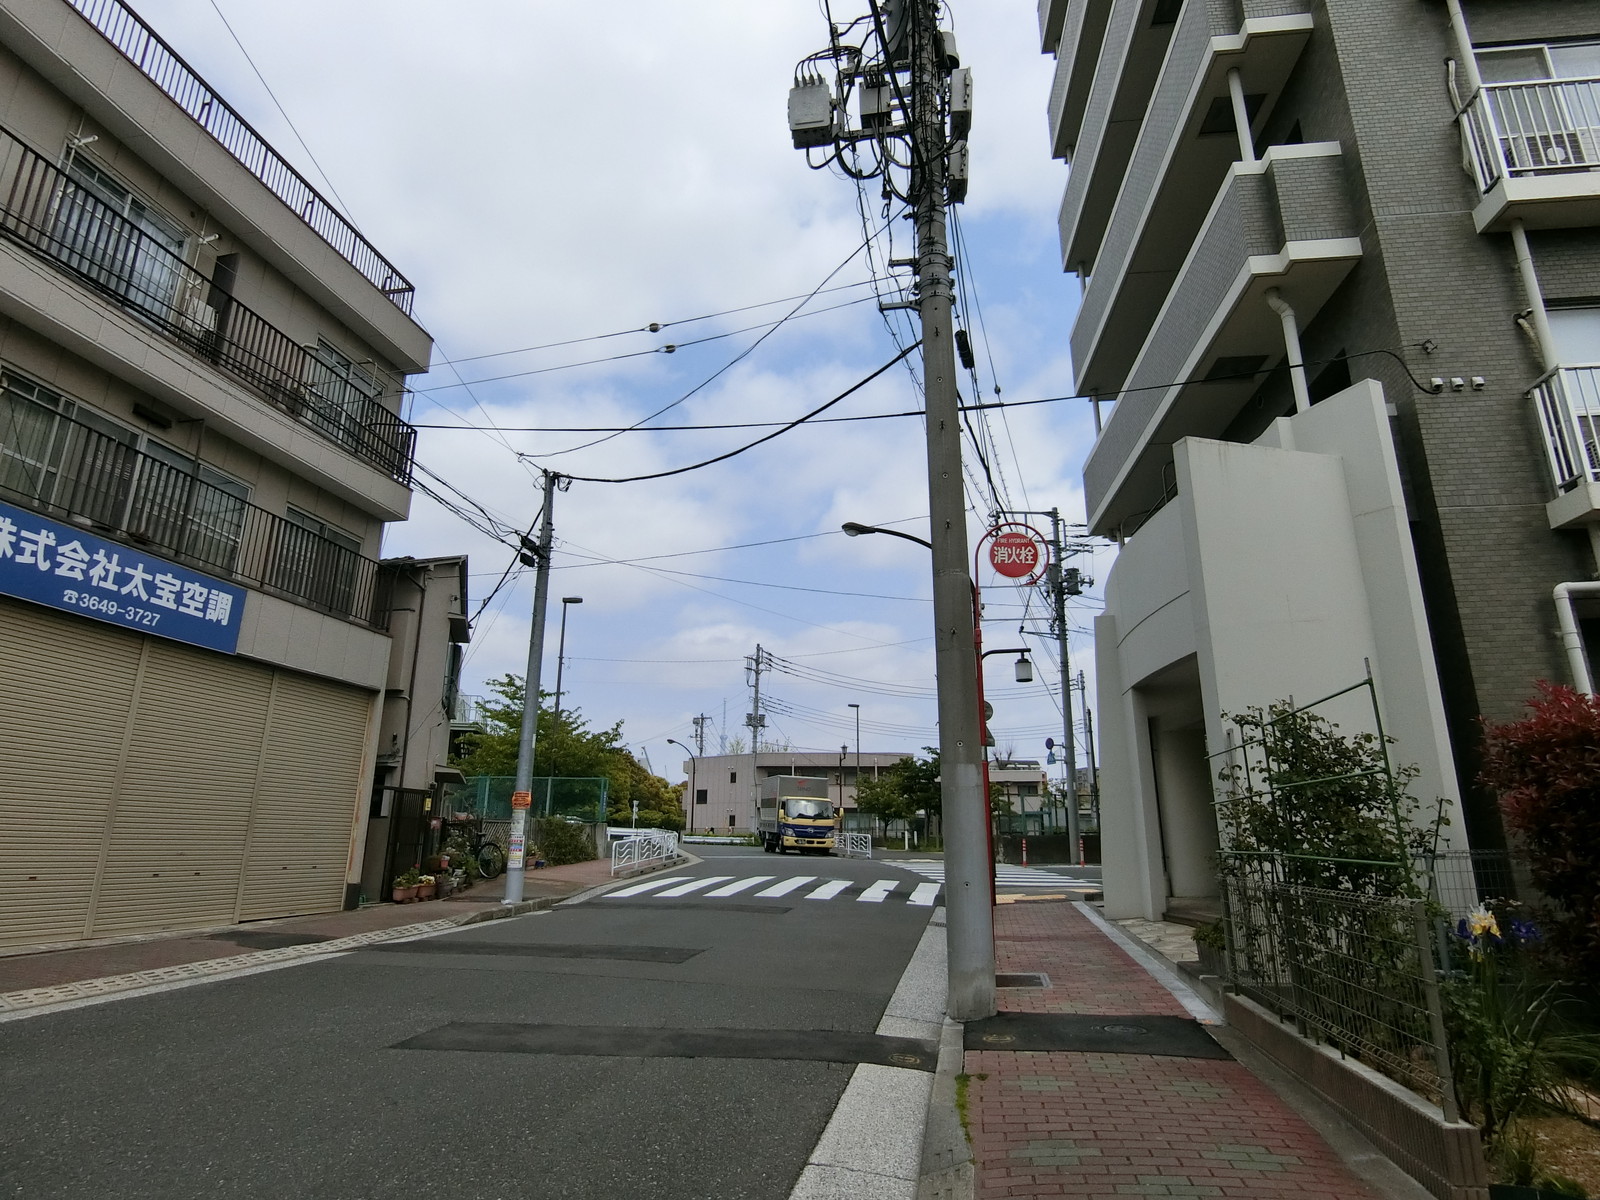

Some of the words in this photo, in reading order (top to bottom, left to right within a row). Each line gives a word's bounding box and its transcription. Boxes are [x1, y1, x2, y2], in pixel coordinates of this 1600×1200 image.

[993, 546, 1035, 564] 消火栓
[79, 593, 161, 627] 3649-3727
